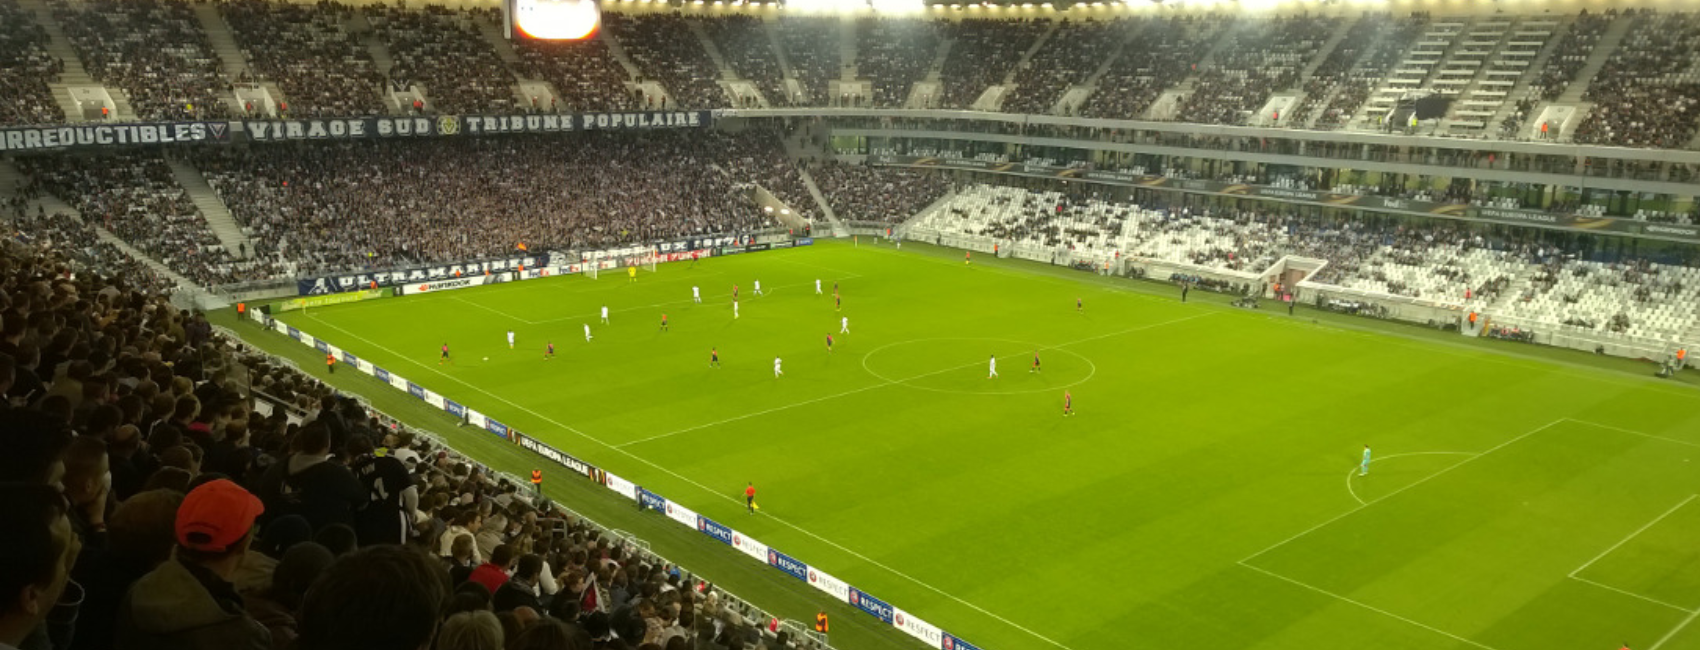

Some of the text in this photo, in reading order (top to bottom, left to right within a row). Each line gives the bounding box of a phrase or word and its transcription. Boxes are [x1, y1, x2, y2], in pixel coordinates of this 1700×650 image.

[376, 118, 430, 136] SUD
[466, 115, 573, 132] TRIBUNE
[582, 111, 699, 129] POPULAIRE
[521, 436, 589, 477] UEFA EUROPA LEAGUE
[706, 523, 731, 541] RESPECT
[742, 538, 767, 558] RESPECT
[778, 556, 806, 577] RESPECT
[818, 575, 848, 597] RESPECT
[860, 596, 892, 619] RESPECT
[905, 618, 940, 643] RESPECT
